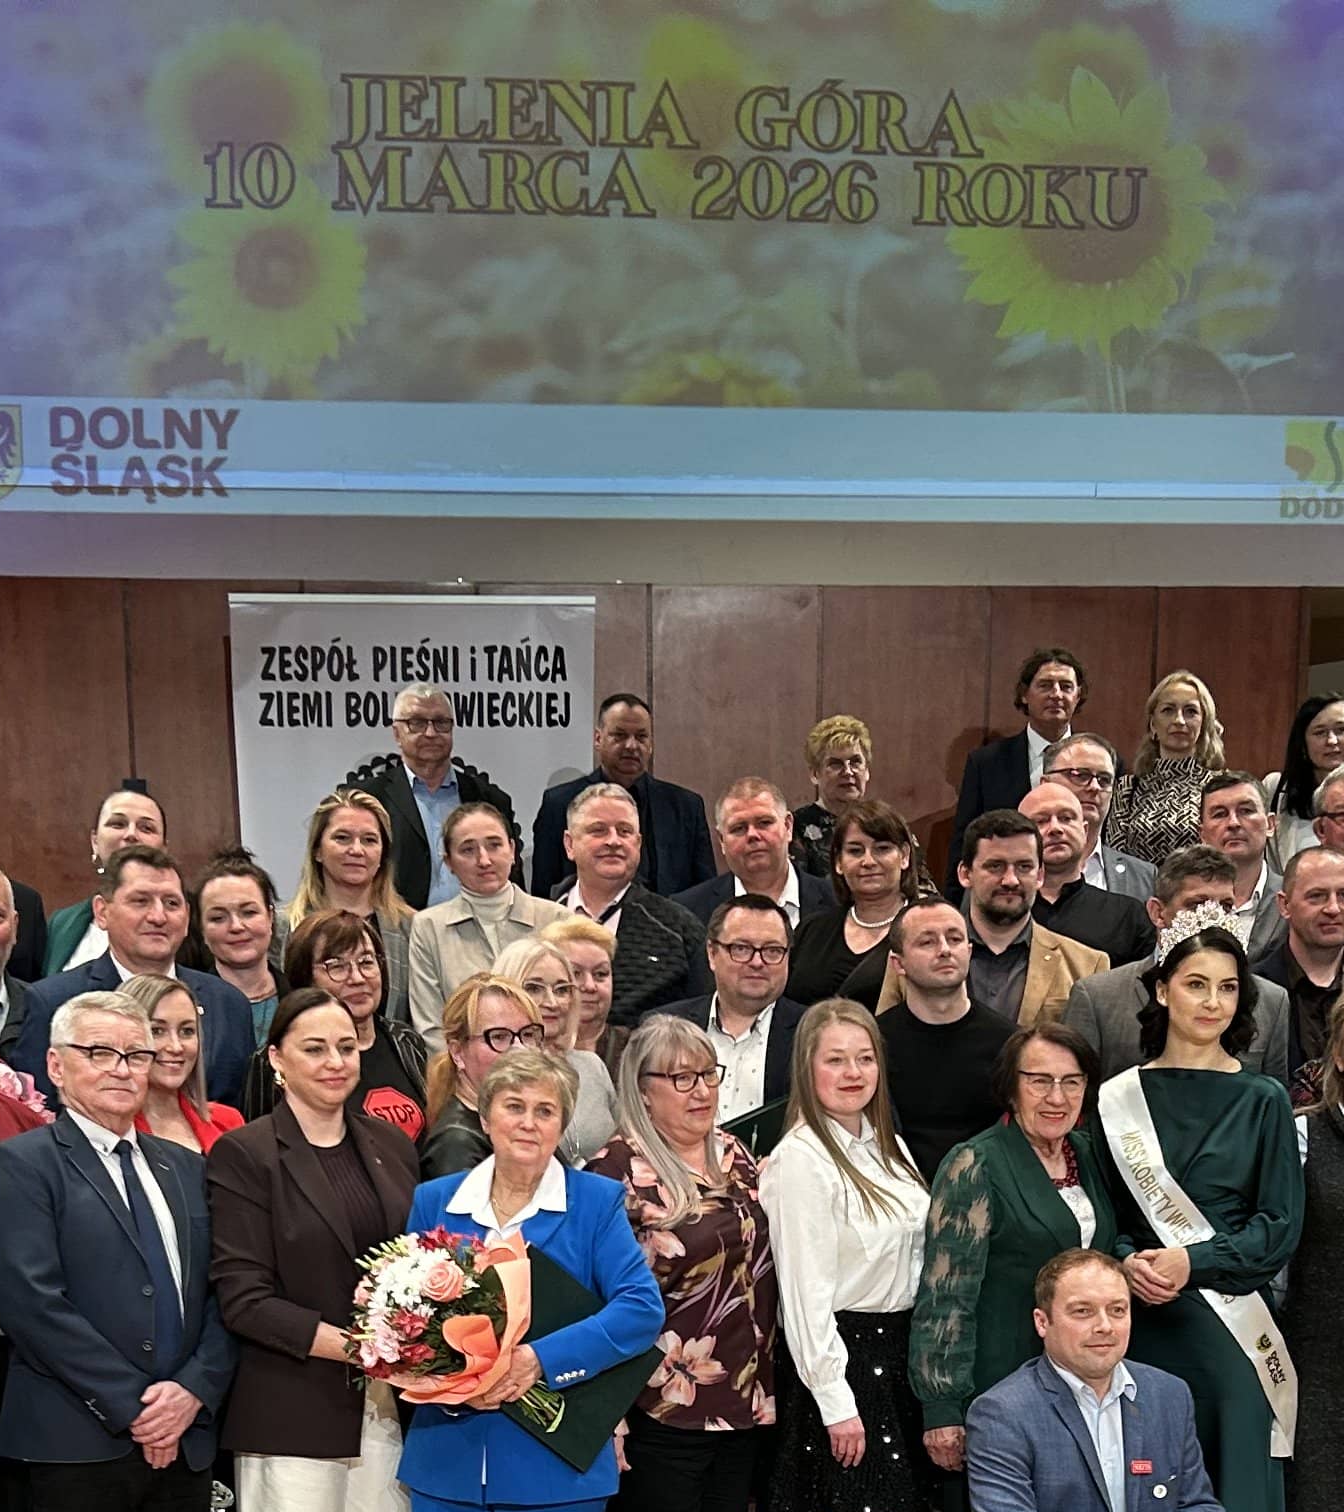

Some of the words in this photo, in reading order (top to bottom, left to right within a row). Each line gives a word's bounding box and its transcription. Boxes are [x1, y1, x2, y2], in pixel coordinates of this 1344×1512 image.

[341, 74, 699, 150] JELENIA
[735, 79, 984, 158] GÓRA
[204, 142, 296, 210] 10
[331, 144, 654, 218] MARCA
[691, 155, 879, 224] 2026
[912, 161, 1148, 231] ROKU
[49, 406, 240, 449] DOLNY
[51, 444, 229, 504] ŚLĄSK
[260, 637, 360, 682] ZESPÓŁ
[373, 638, 459, 683] PIEŚNI
[470, 646, 477, 681] i
[484, 636, 567, 683] TAŃCA
[259, 691, 333, 727] ZIEMI
[345, 691, 570, 728] BOLWIECKIEJ
[373, 1104, 415, 1123] STOP
[1120, 1130, 1148, 1161] MISS
[1129, 1160, 1175, 1215] KOBIETY
